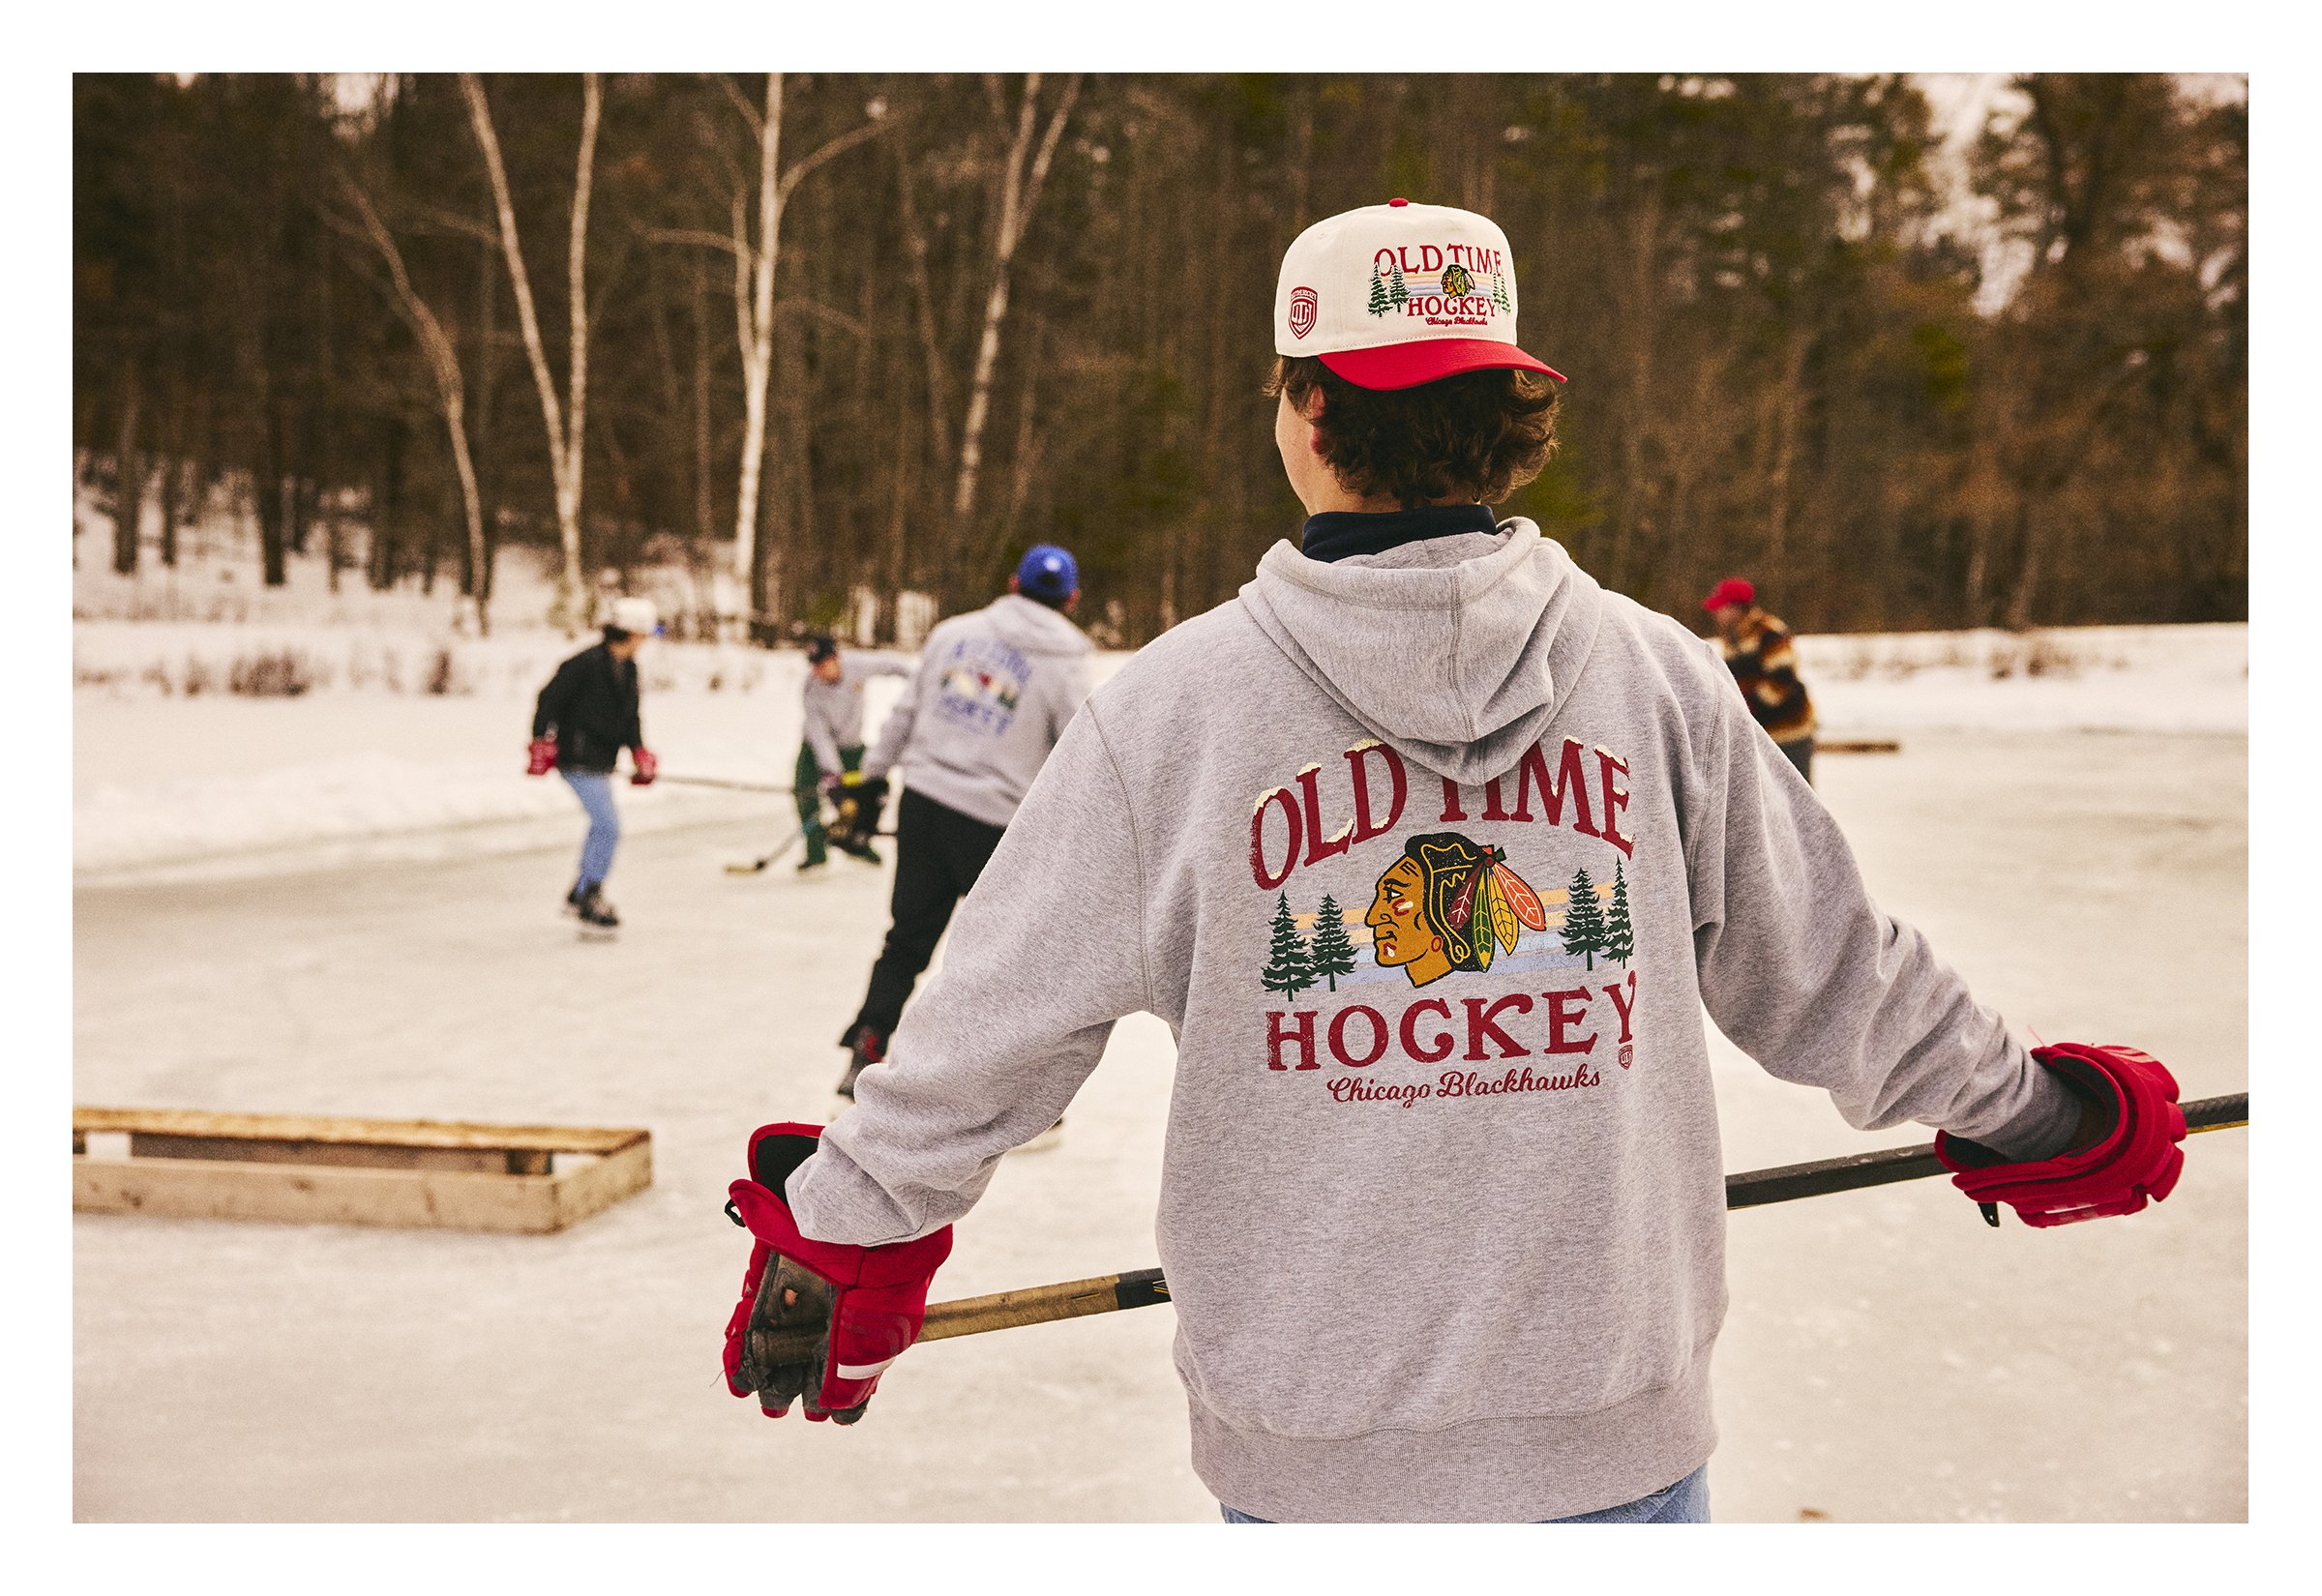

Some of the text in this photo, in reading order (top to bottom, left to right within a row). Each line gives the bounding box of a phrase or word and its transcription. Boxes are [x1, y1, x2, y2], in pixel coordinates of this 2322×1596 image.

[1374, 243, 1501, 277] OLD TIME
[1407, 295, 1495, 317] HOCKEY
[1425, 316, 1453, 327] Chicago
[1249, 738, 1408, 892] OLD
[1265, 970, 1637, 1072] HOCKEY
[1326, 1063, 1601, 1109] Chicago Blackhawks
